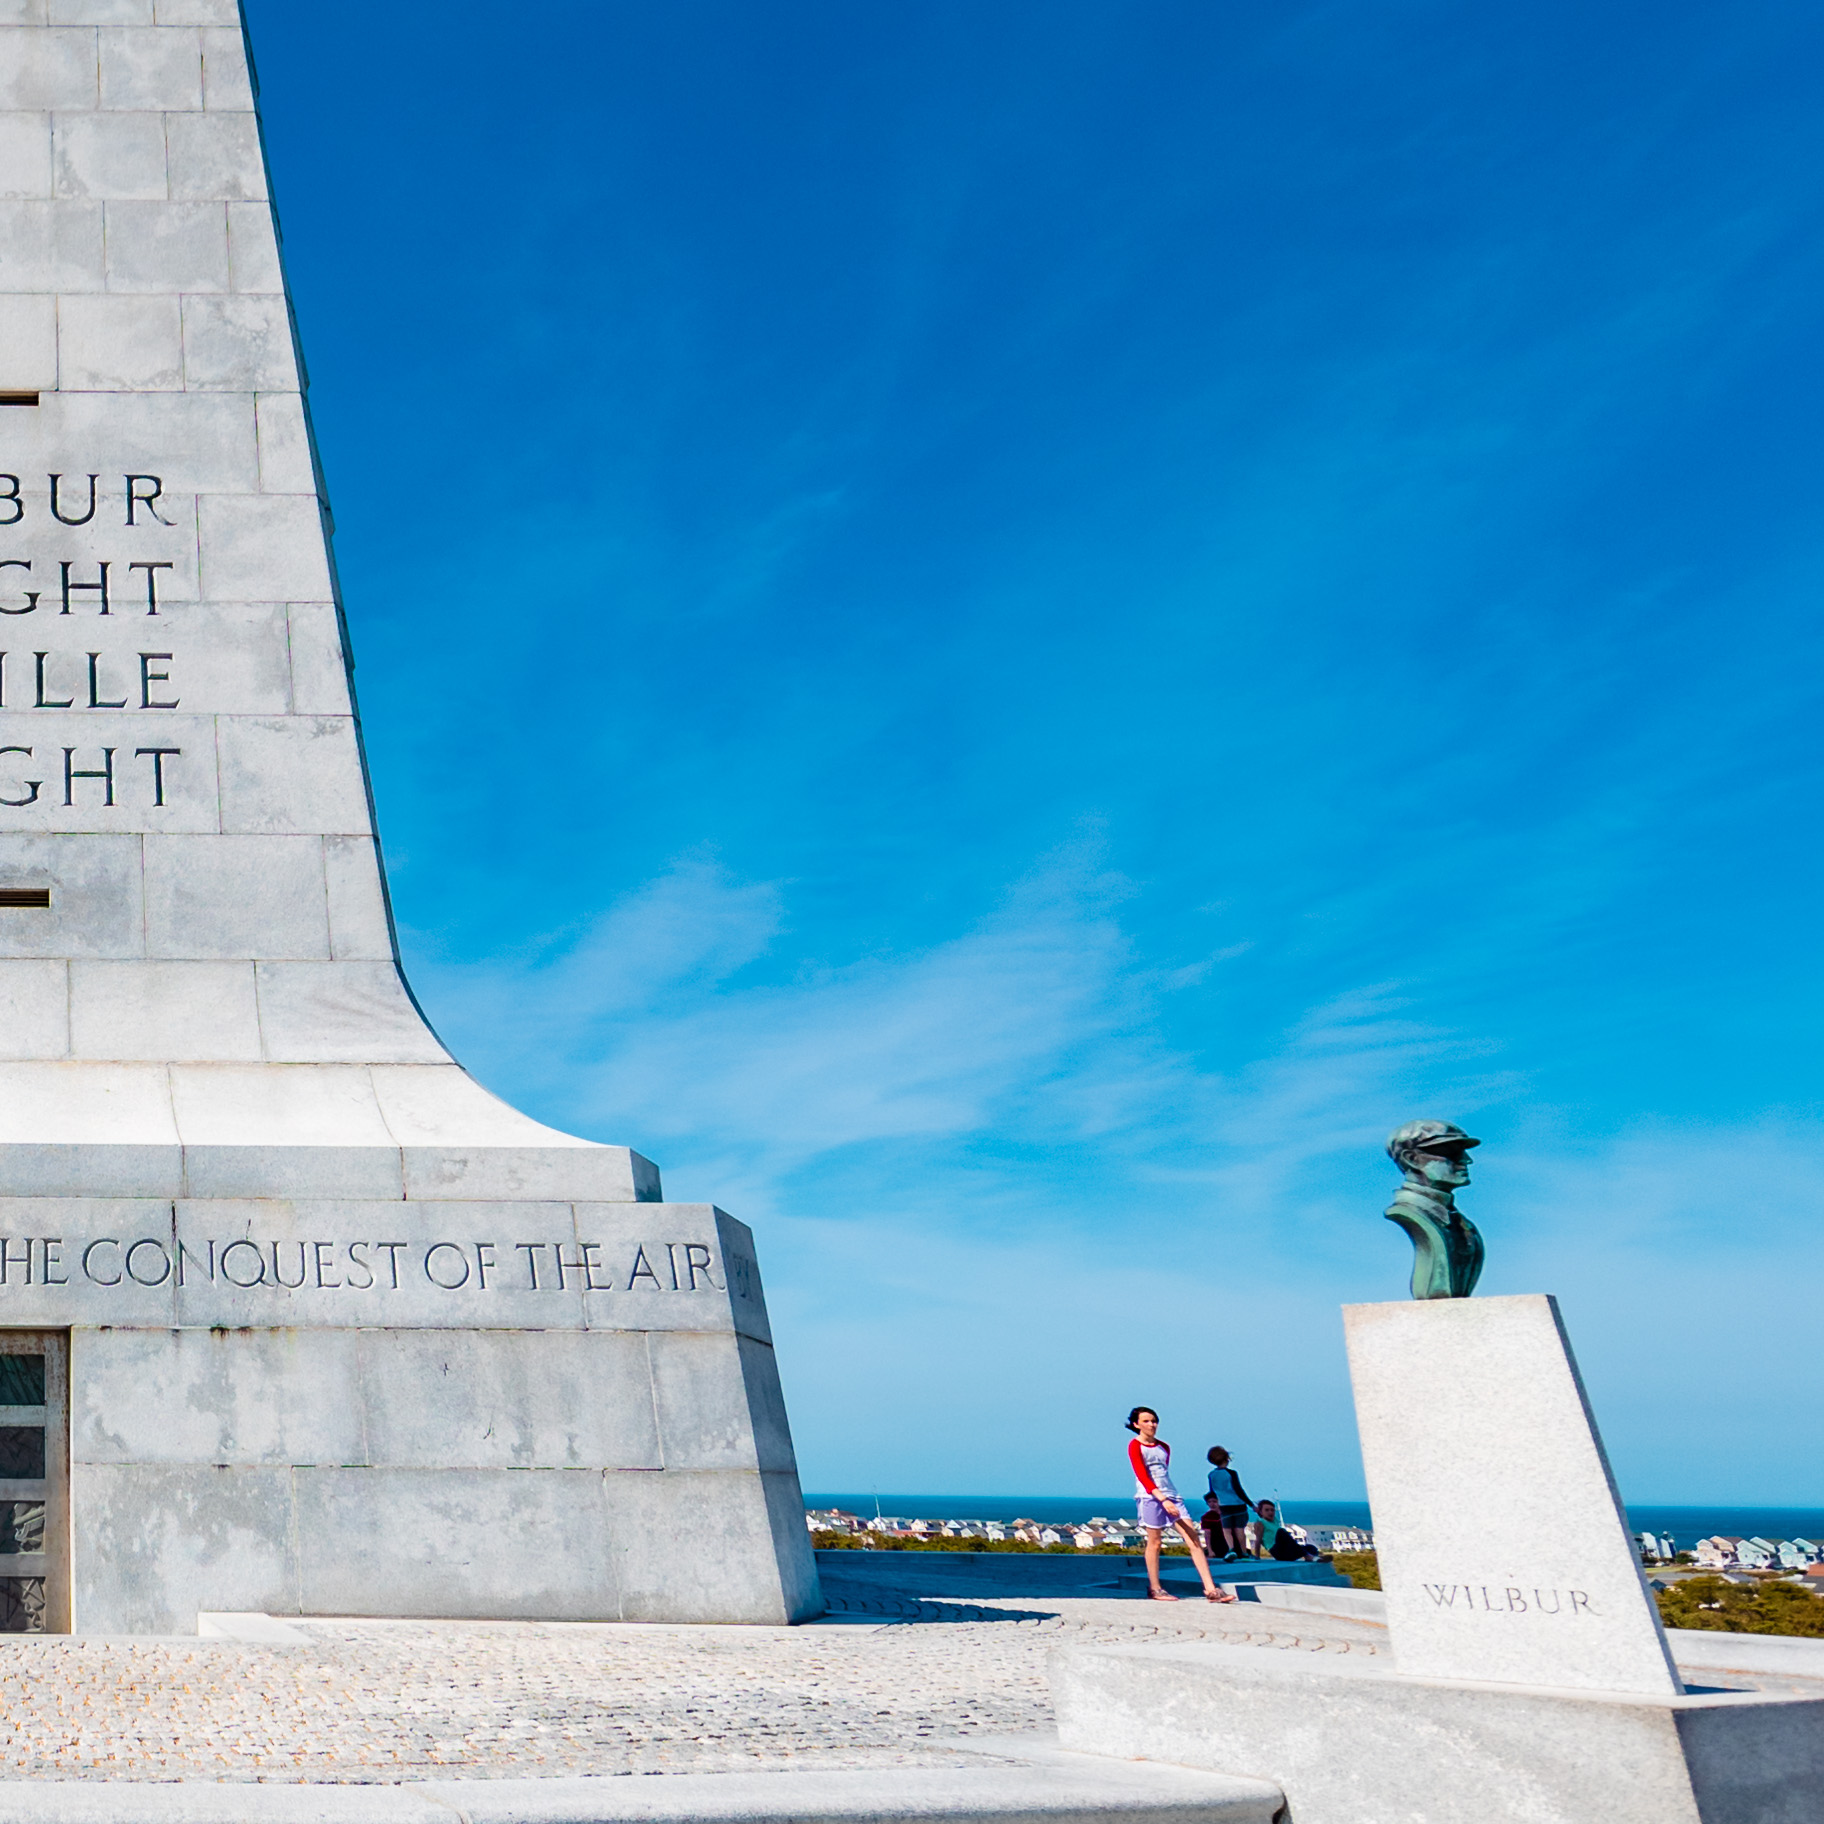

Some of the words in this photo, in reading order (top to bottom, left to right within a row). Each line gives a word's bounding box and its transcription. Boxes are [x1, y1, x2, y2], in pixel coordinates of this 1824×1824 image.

[81, 1237, 408, 1290] CONQUEST
[425, 1241, 496, 1290] OF
[515, 1242, 614, 1291] THE
[626, 1242, 726, 1292] AIR
[1423, 1583, 1602, 1616] WILBUR
